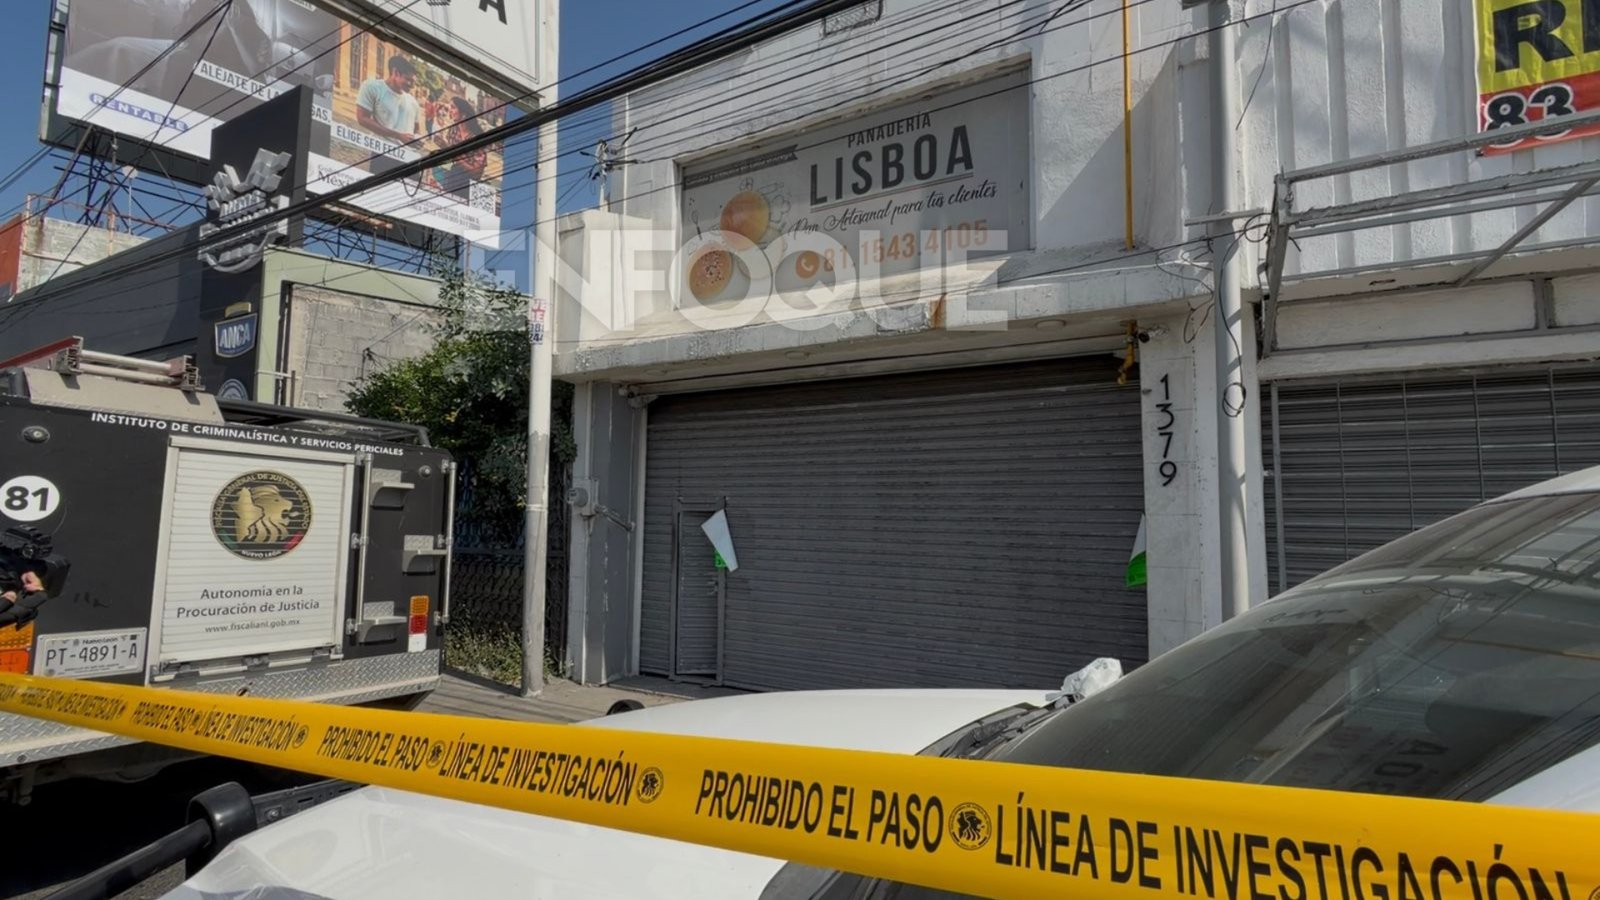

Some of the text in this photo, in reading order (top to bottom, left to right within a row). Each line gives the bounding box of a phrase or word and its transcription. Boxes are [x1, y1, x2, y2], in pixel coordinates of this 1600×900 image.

[848, 111, 931, 149] PANADERÍA
[1484, 82, 1576, 148] 83
[336, 125, 405, 160] ELIGE SER FELIZ
[810, 124, 974, 206] LISBOA
[788, 179, 998, 240] Pan Artesanal para tus clientes
[91, 412, 405, 457] INSTITUTO DE CRIMINALÍSTICA Y SERVICIOS PERICIALES
[1156, 373, 1177, 487] 1379
[4, 485, 50, 512] 81
[176, 599, 321, 619] Procuración de Justicia
[200, 585, 304, 601] Autonomía en la
[46, 643, 137, 667] PT-4891-A
[317, 725, 638, 806] PROHIBIDO EL PASO LÍNEA DE INVESTIGACIÓN
[695, 769, 824, 834] PROHIBIDO
[827, 785, 859, 841] EL
[866, 789, 944, 854] PASO
[995, 792, 1099, 880] LÍNEA
[1109, 818, 1162, 890] DE
